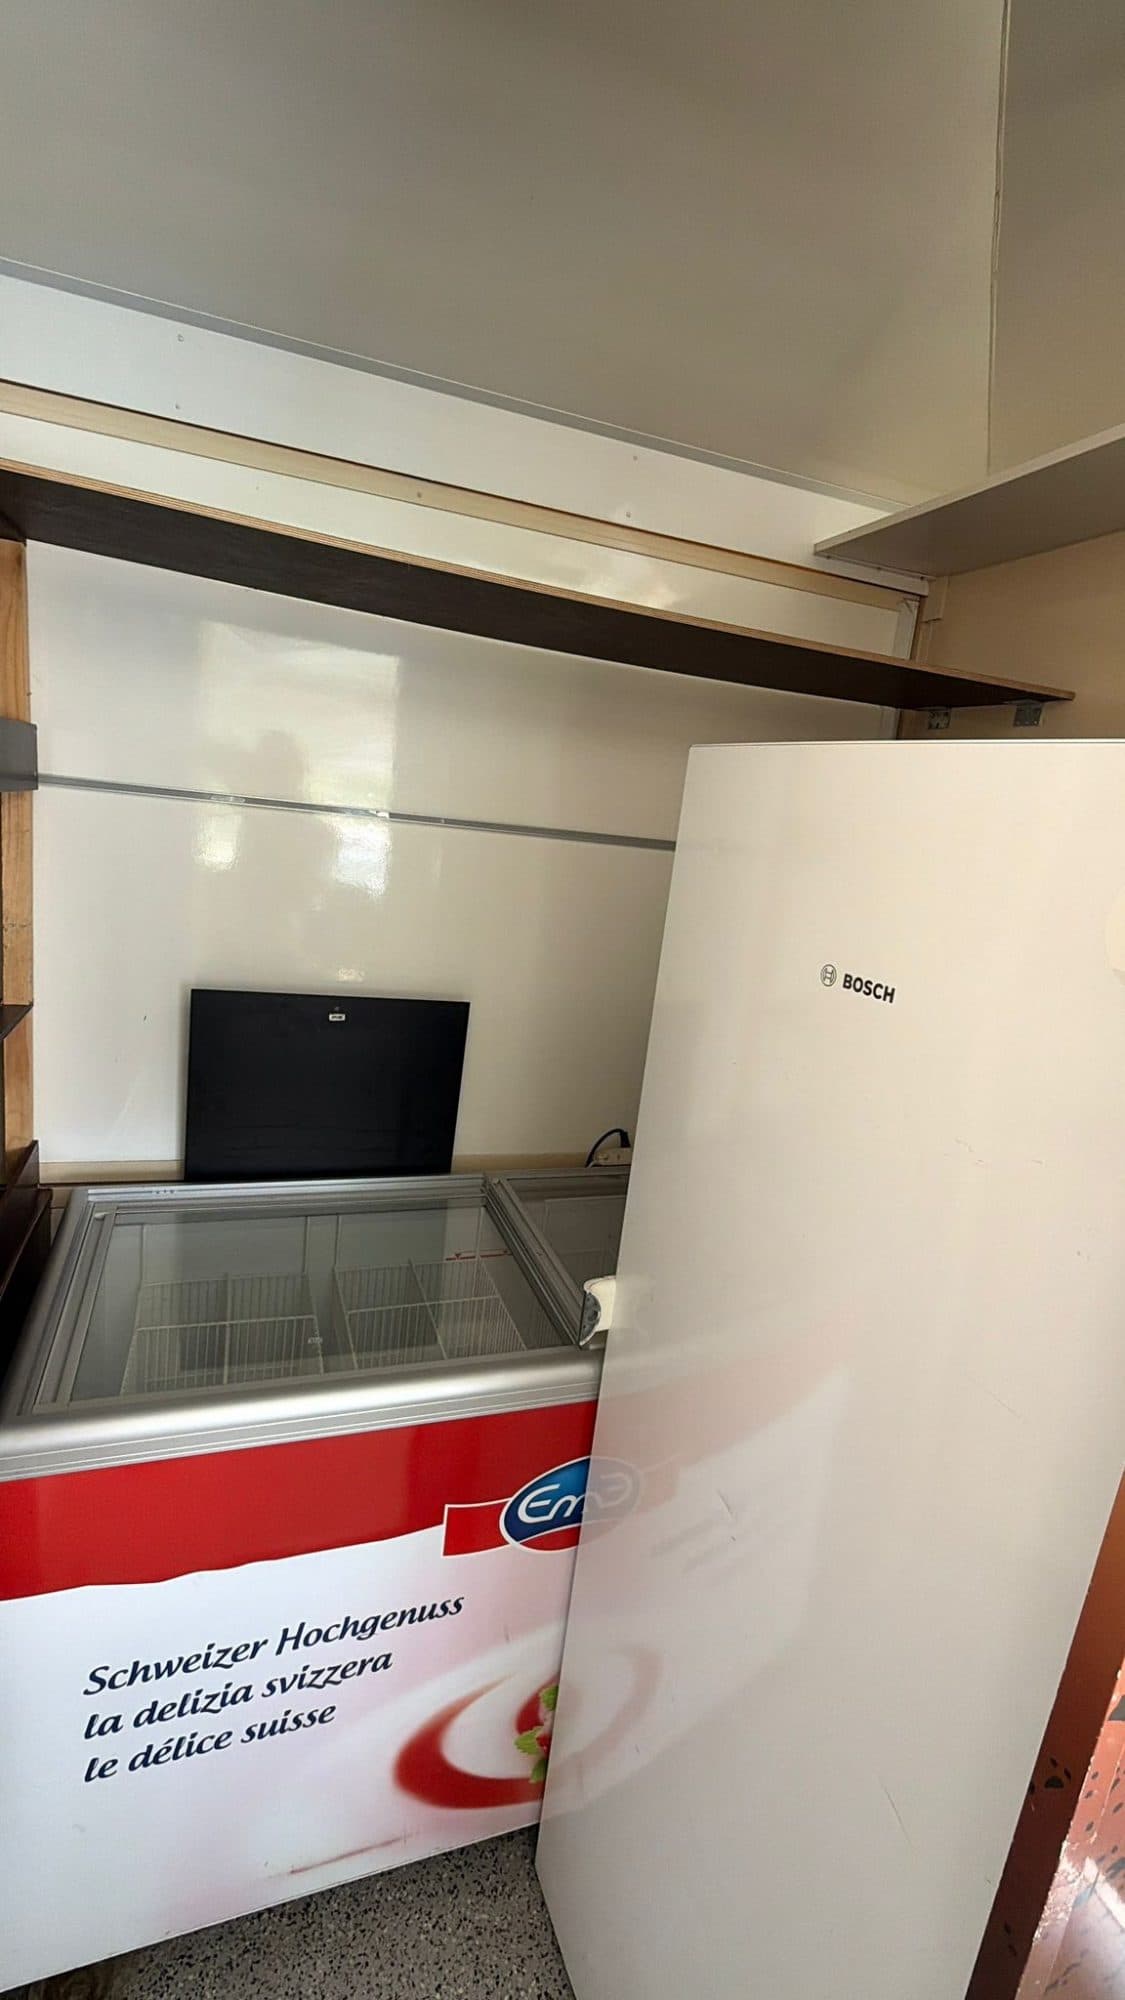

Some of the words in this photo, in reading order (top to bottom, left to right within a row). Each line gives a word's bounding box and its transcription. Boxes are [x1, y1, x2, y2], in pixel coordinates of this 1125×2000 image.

[842, 973, 896, 1004] BOSCH
[517, 1483, 586, 1524] Em
[83, 1639, 269, 1696] Schweizer
[275, 1596, 465, 1656] Hochgenuss
[84, 1713, 123, 1740] la
[133, 1682, 254, 1729] delizia
[261, 1652, 393, 1698] svizzera
[84, 1757, 118, 1783] le
[128, 1723, 233, 1772] délice
[241, 1705, 337, 1744] suisse
